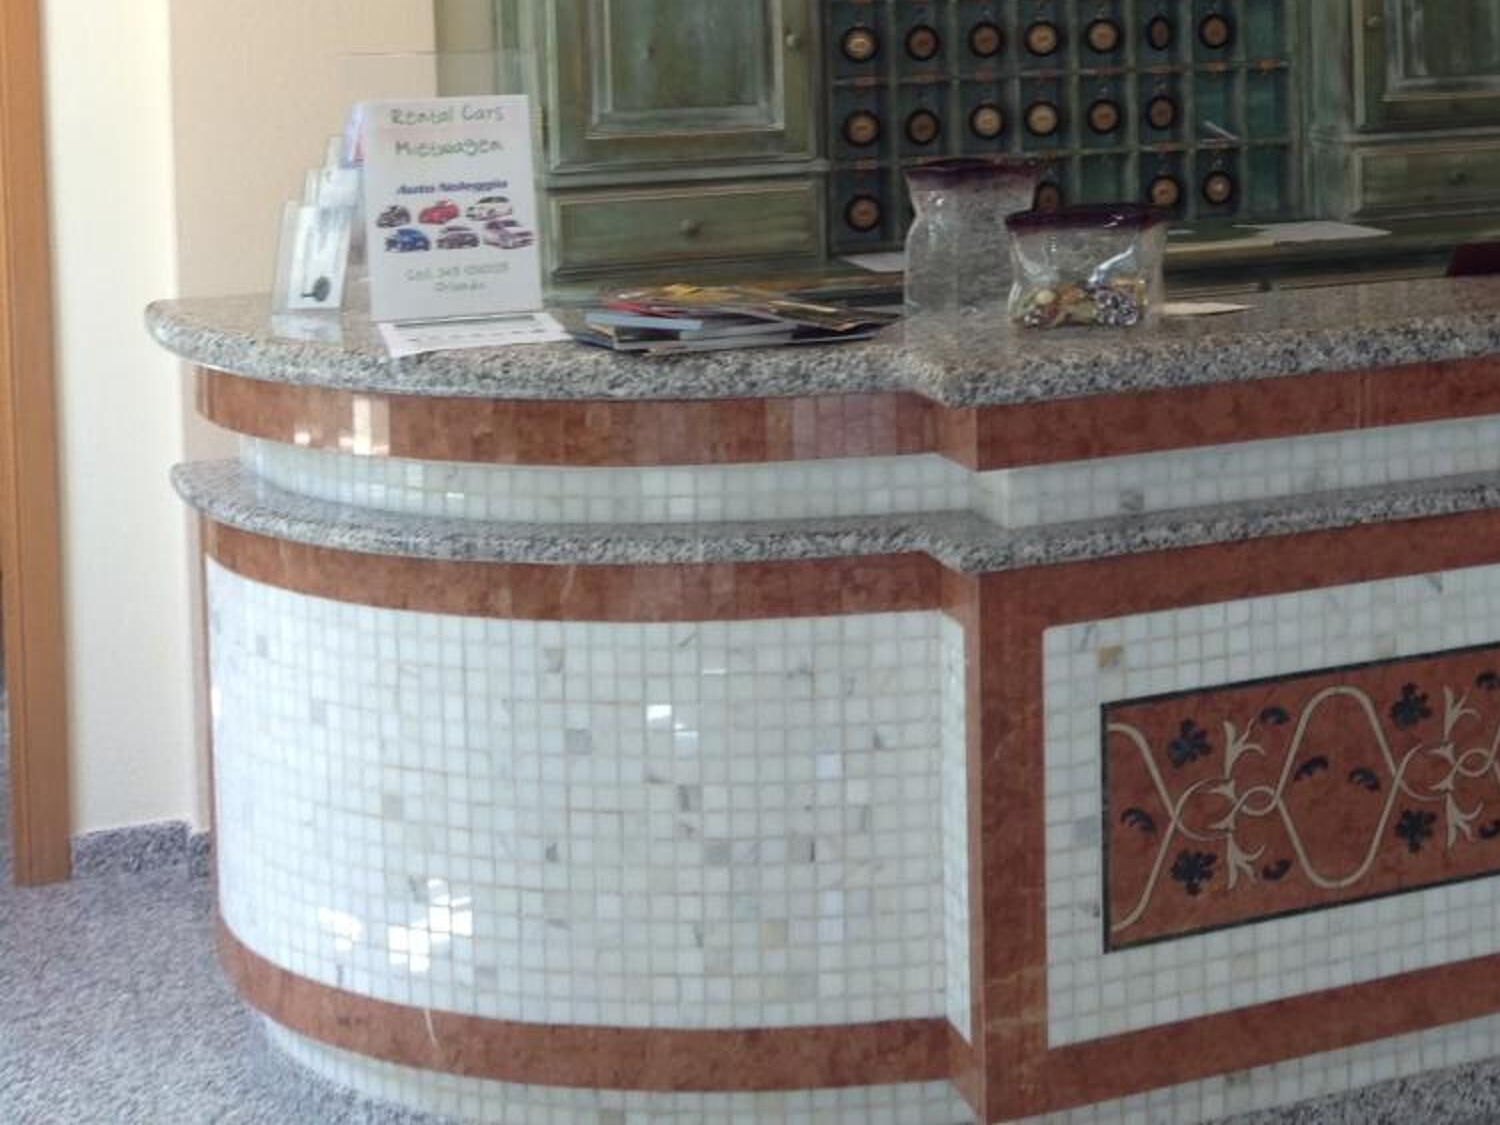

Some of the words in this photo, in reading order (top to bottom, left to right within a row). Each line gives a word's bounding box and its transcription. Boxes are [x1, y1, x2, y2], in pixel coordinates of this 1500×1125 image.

[391, 106, 453, 125] Rental
[462, 103, 504, 122] Cars
[395, 139, 503, 157] Mietwagen
[397, 184, 435, 194] Auto
[440, 180, 508, 192] Noleggio
